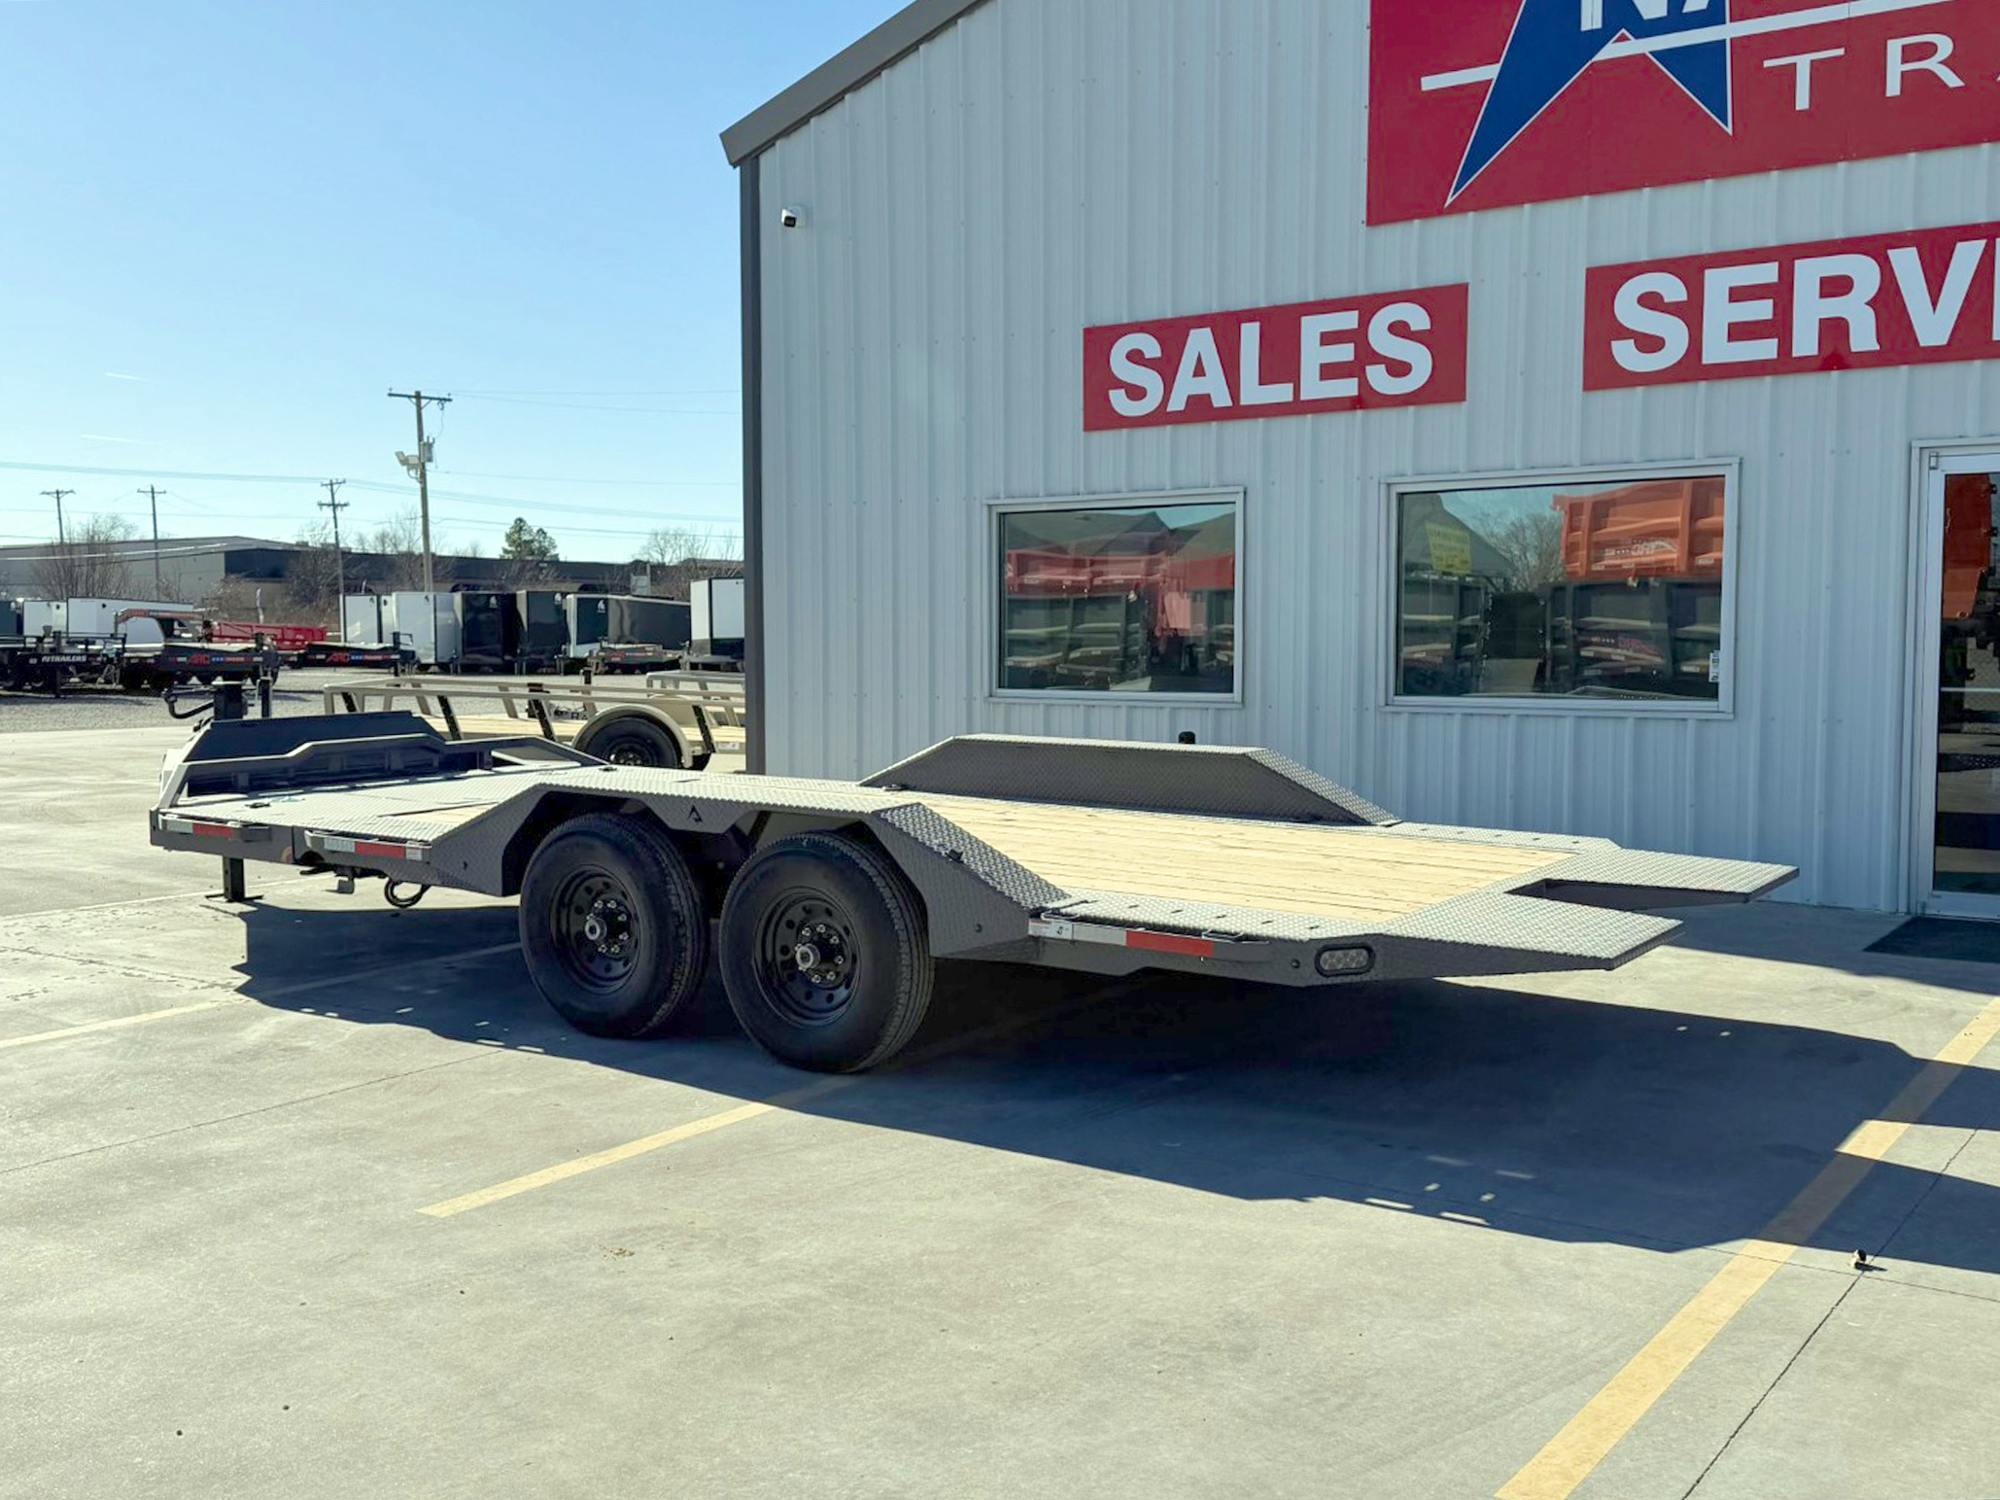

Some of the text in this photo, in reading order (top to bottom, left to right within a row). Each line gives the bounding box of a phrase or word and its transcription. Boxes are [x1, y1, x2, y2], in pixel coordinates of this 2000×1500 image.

[1763, 33, 2000, 111] TR
[1108, 301, 1433, 418] SALES
[1610, 237, 2000, 373] SERV
